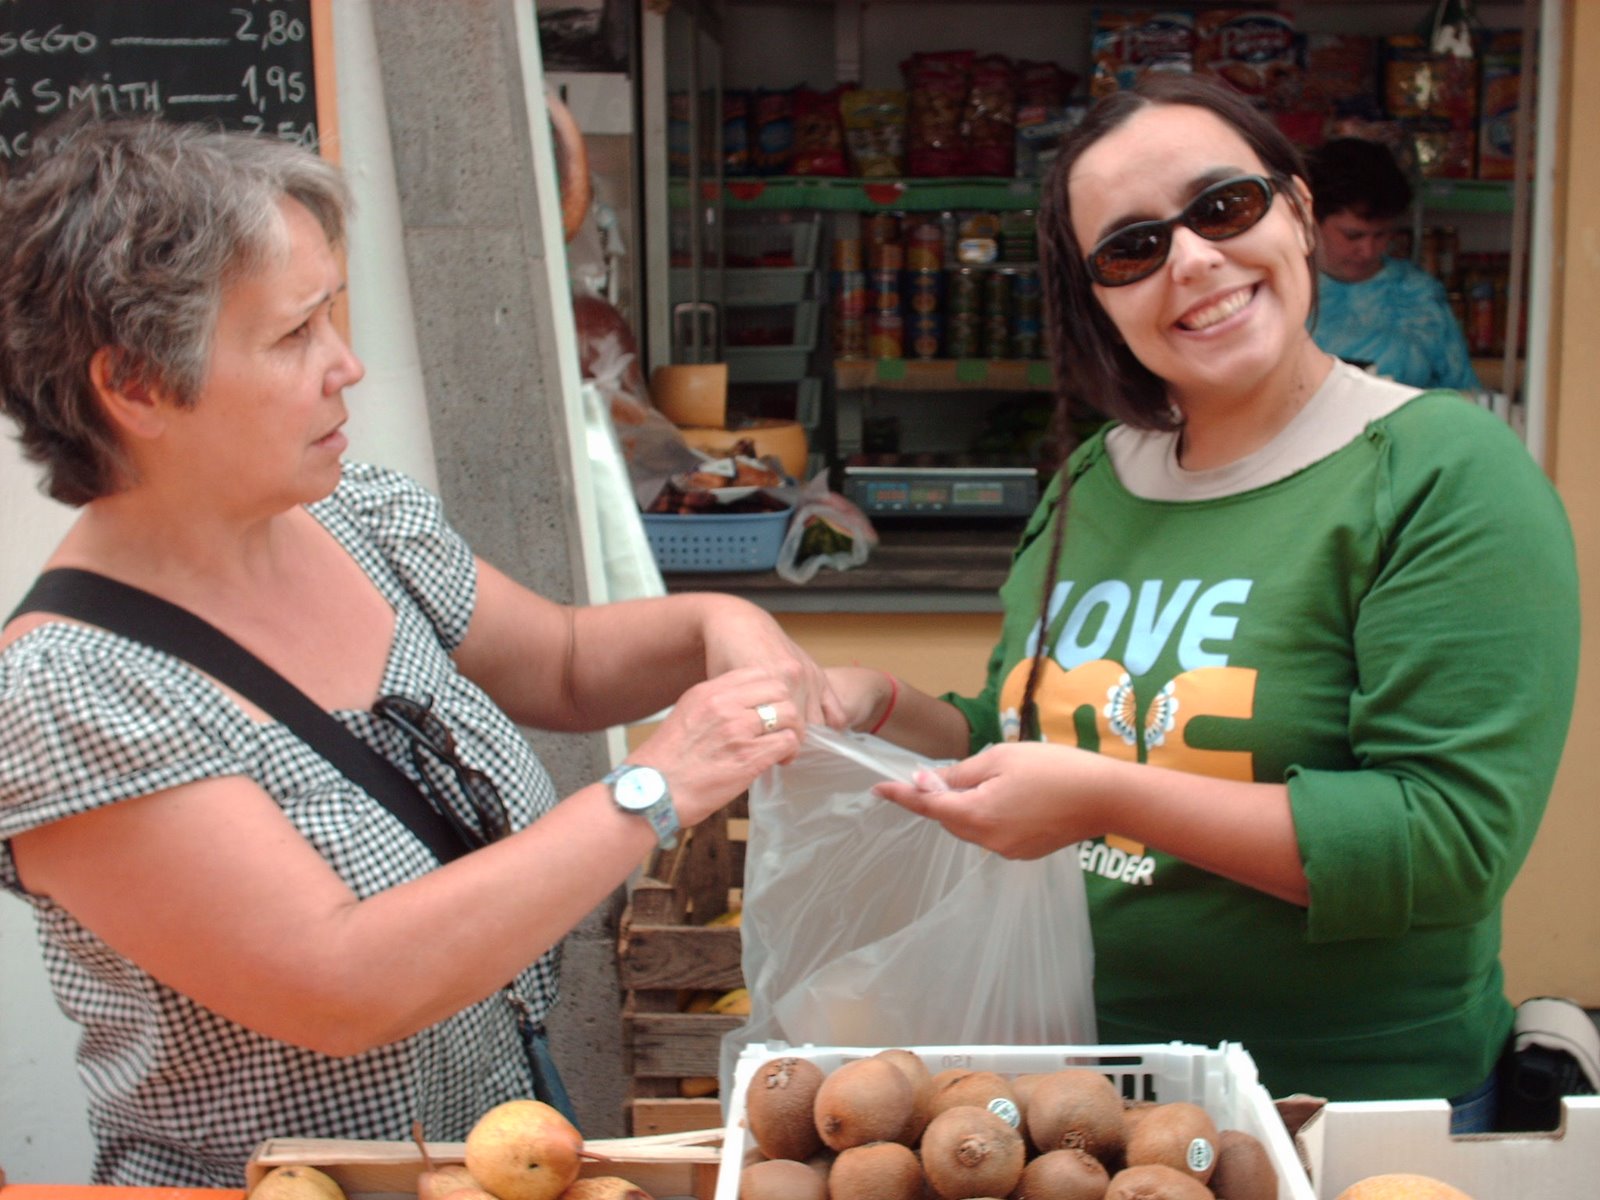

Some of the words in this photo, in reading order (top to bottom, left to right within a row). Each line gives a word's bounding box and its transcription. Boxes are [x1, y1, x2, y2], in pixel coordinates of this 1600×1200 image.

[231, 8, 305, 50] 2,80
[241, 65, 306, 113] 1,95
[1026, 579, 1253, 675] LOVE
[1079, 840, 1156, 886] ENDER
